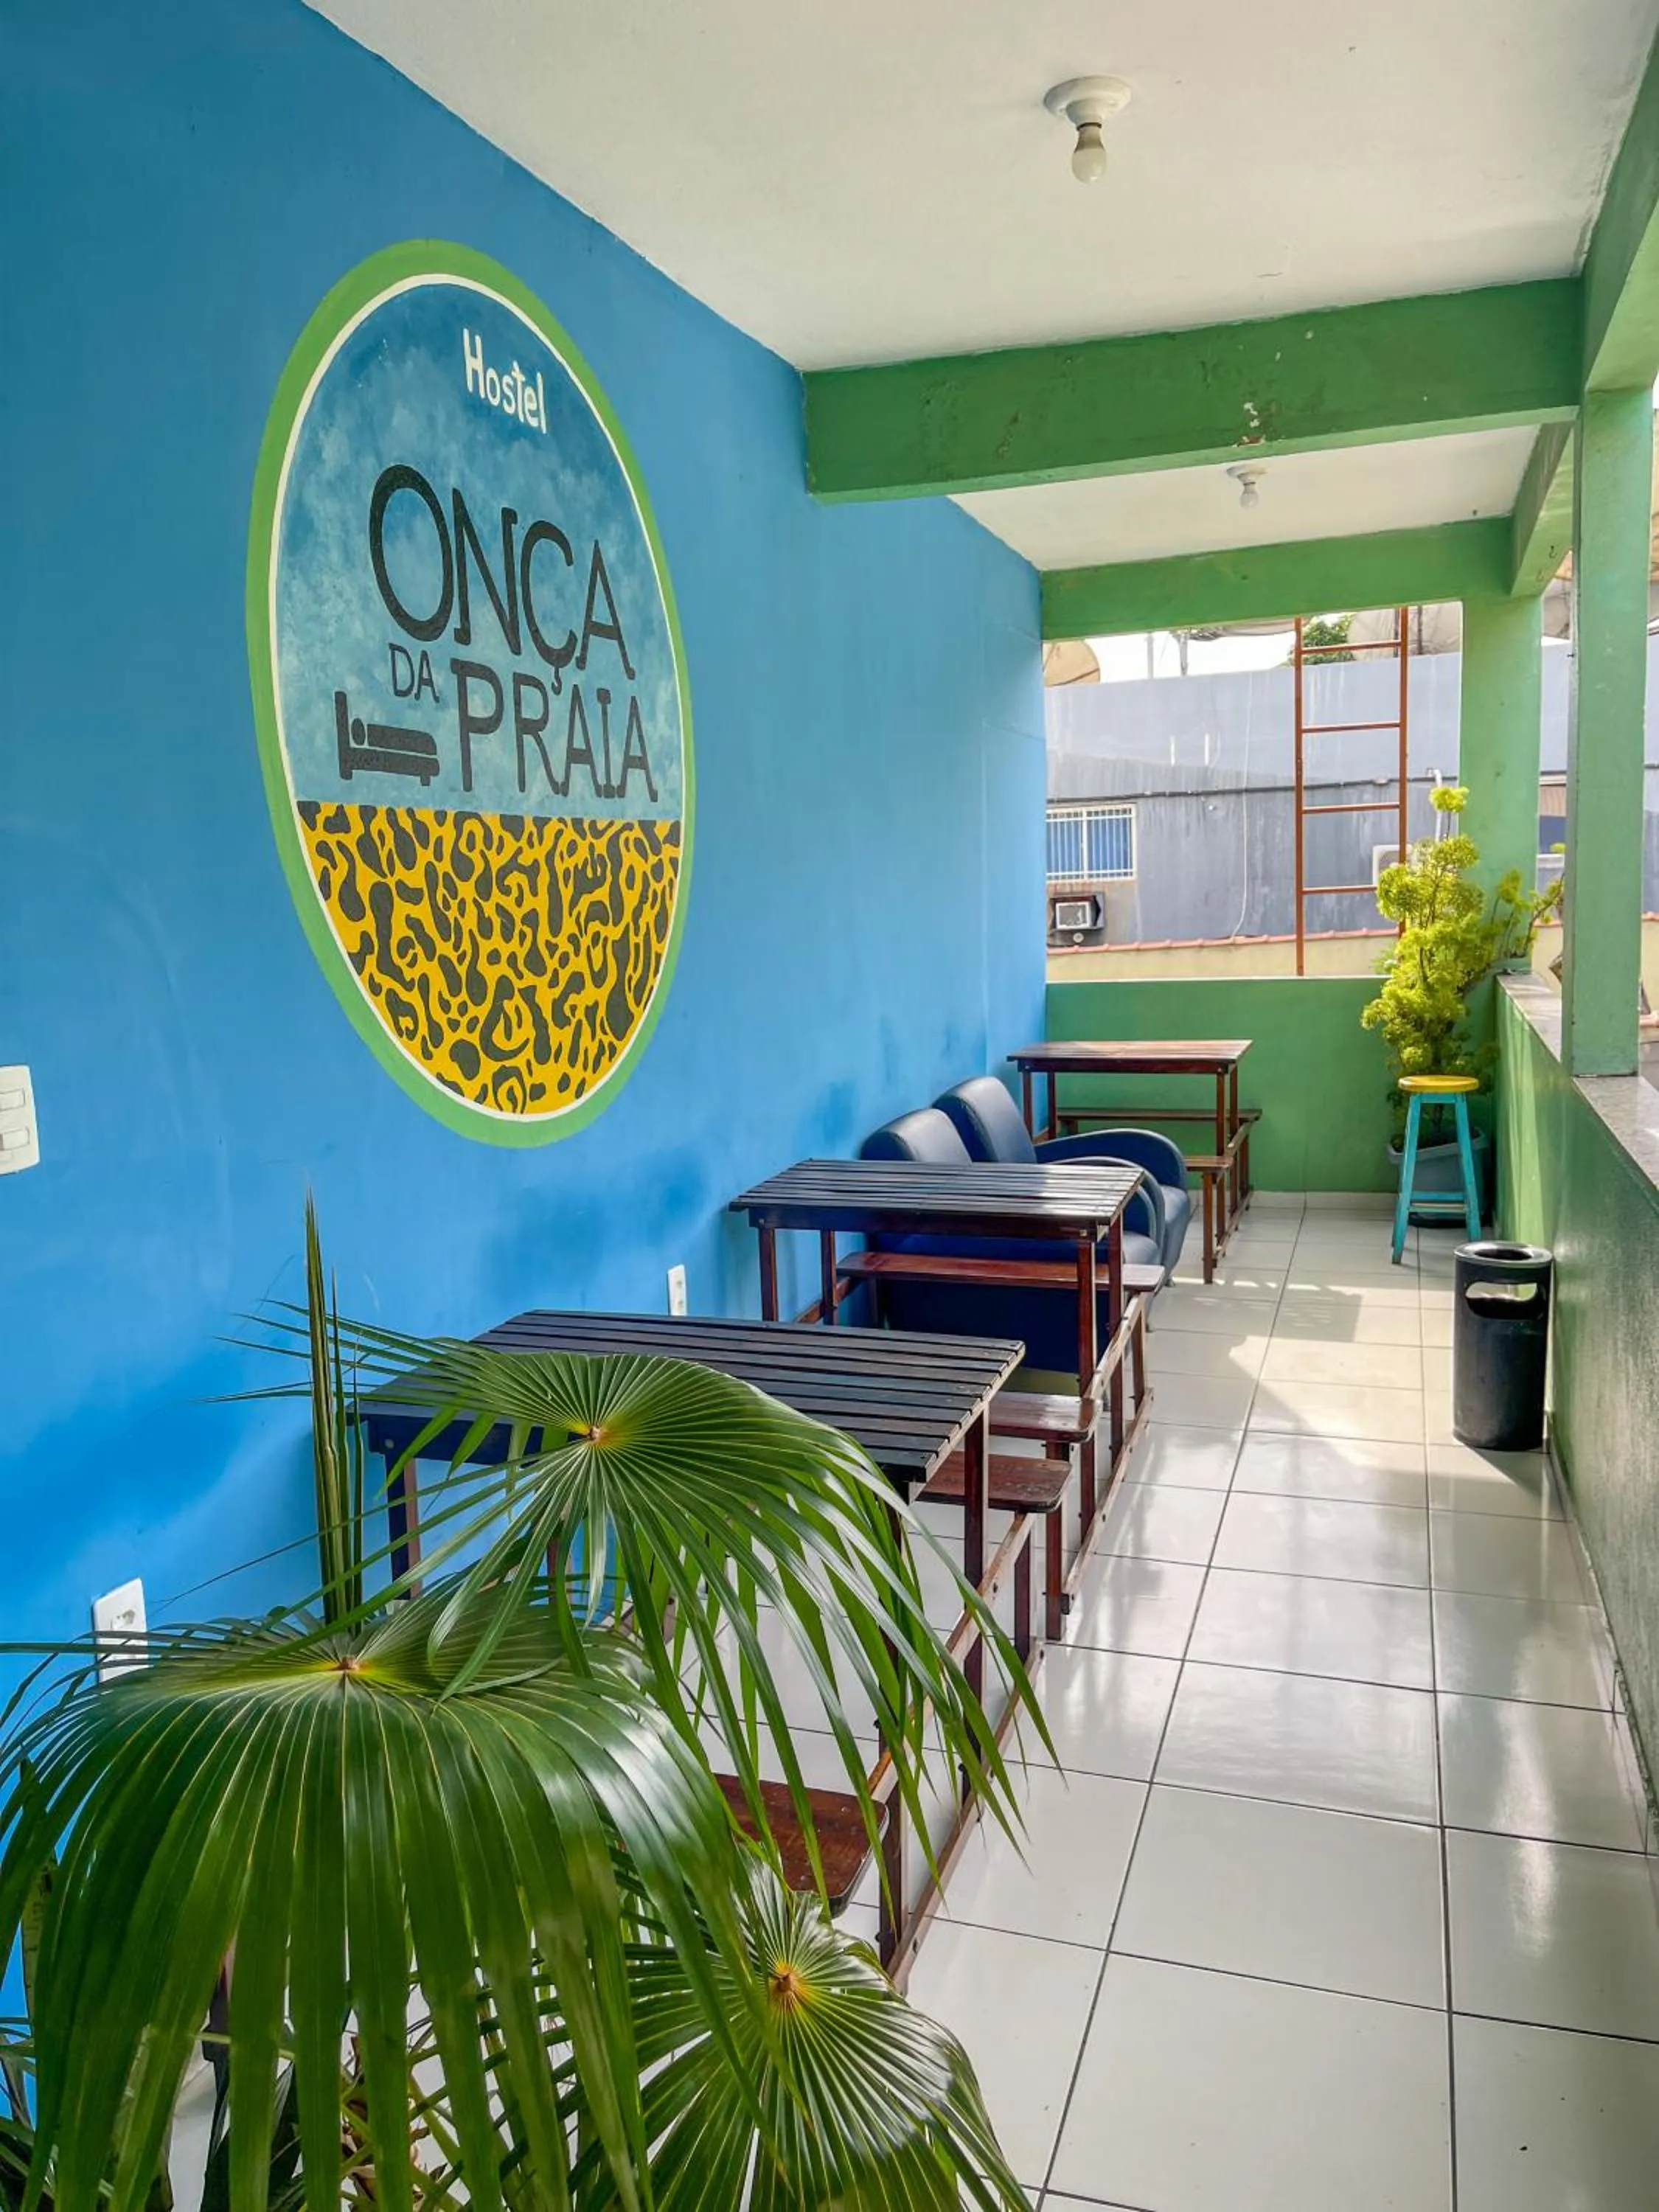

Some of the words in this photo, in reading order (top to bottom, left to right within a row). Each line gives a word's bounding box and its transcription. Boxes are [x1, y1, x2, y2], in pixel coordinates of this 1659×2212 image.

[463, 328, 547, 434] Hostel
[370, 464, 636, 695] ONÇA
[389, 643, 439, 703] DA
[451, 658, 658, 802] PRAIA
